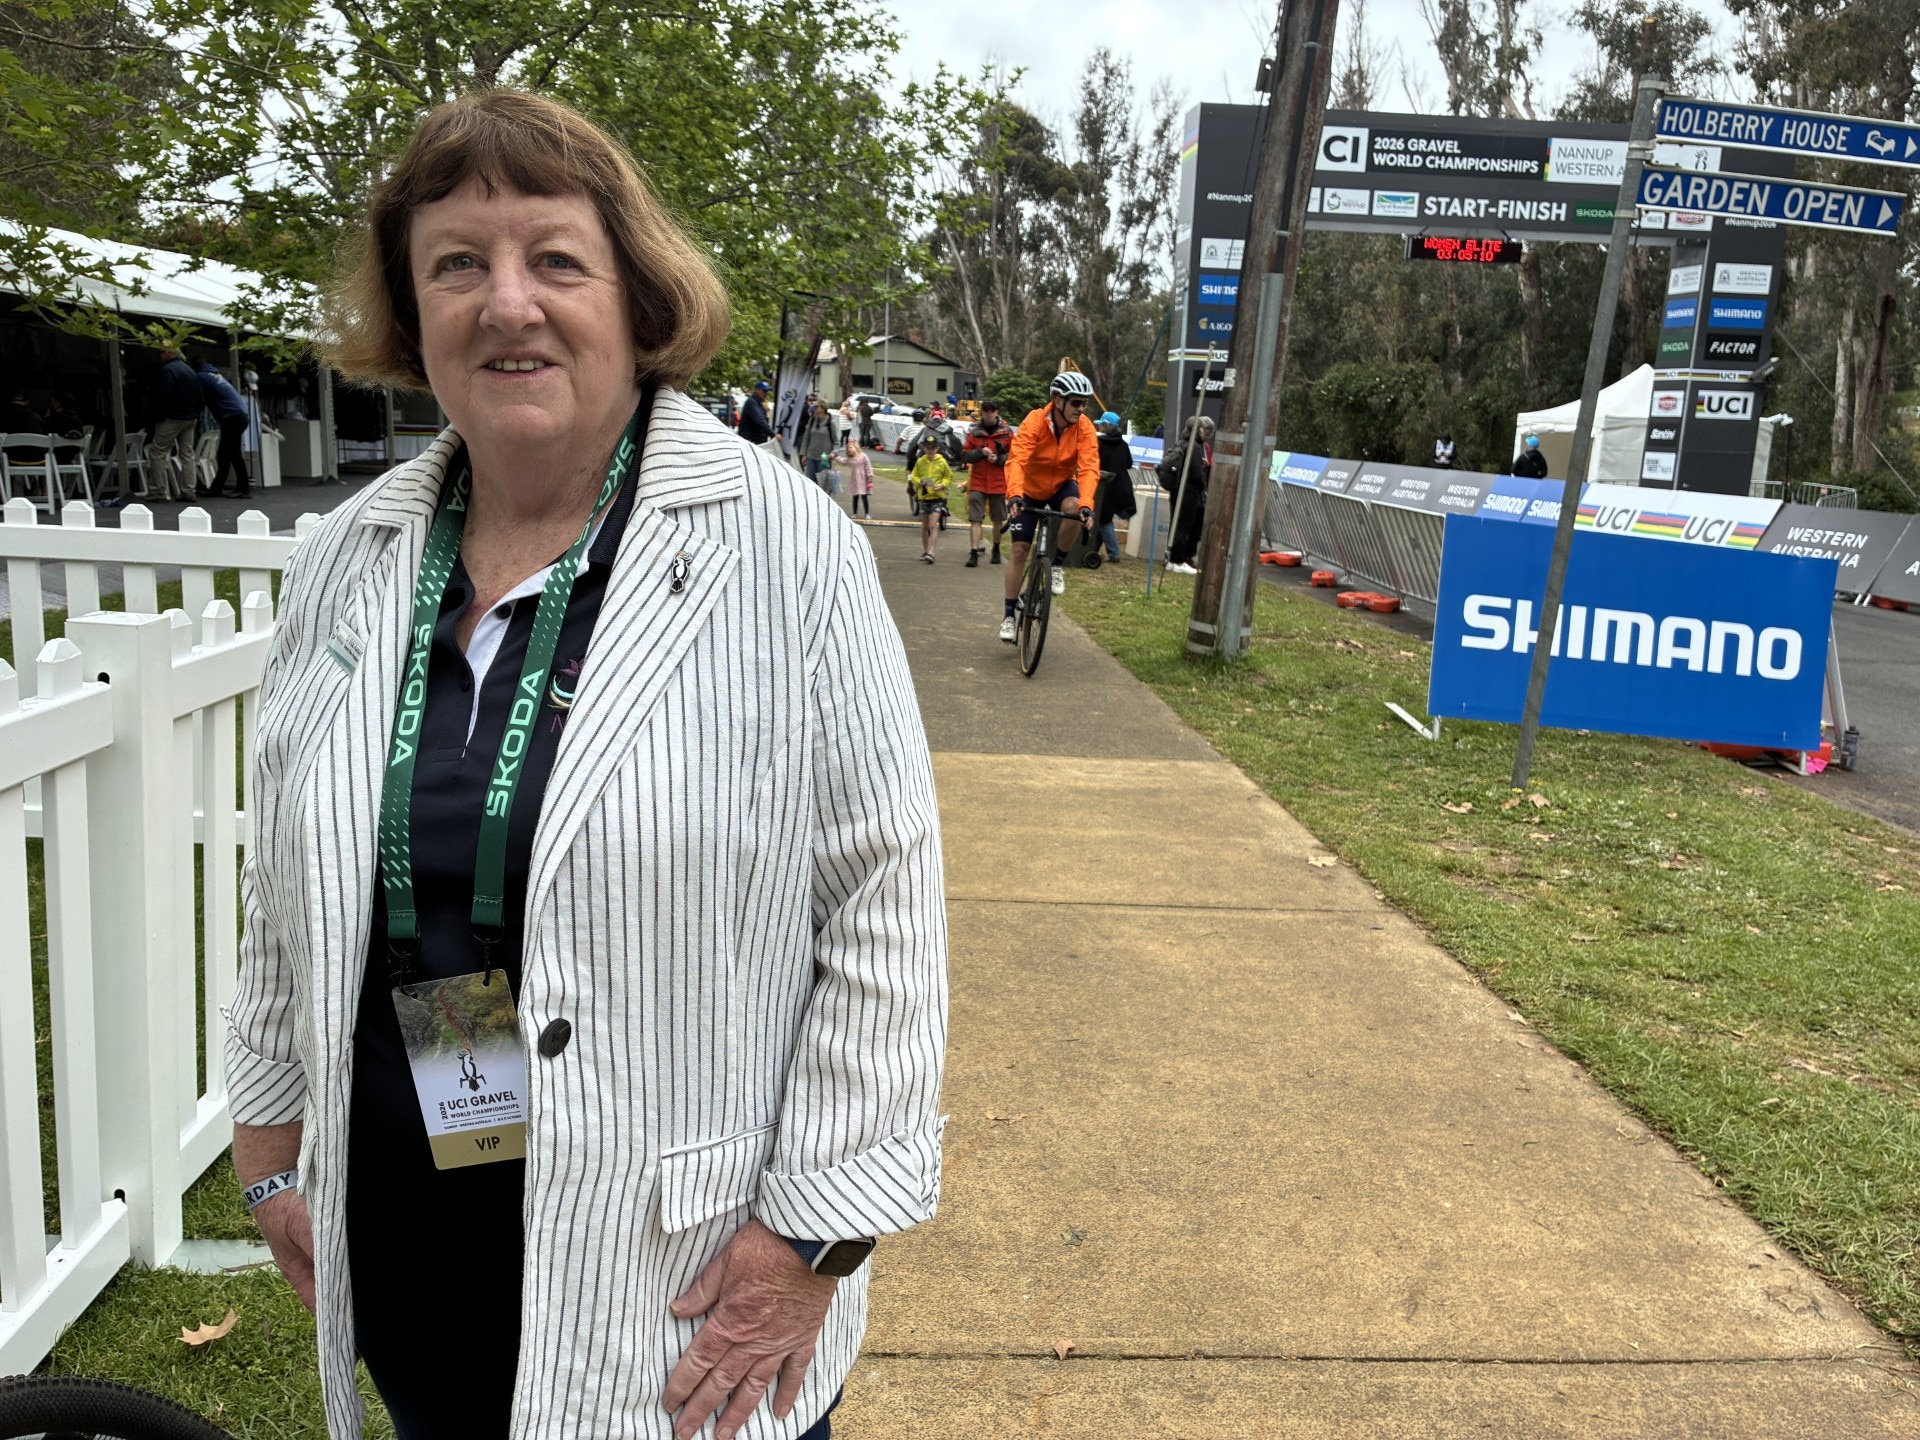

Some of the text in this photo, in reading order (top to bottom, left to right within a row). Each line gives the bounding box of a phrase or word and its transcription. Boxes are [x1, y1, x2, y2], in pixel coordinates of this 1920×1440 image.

[1662, 105, 1850, 151] HOLBERRY HOUSE
[1323, 135, 1360, 164] CI
[1373, 137, 1461, 154] 2026 GRAVEL
[1557, 146, 1613, 160] NANNUP
[1373, 152, 1539, 174] WORLD CHAMPIONSHIPS
[1555, 162, 1614, 177] WESTERN
[1643, 172, 1865, 227] GARDEN OPEN
[1424, 196, 1567, 222] START-FINISH
[1424, 237, 1502, 252] WOMEN ELITE
[1437, 250, 1494, 263] 03:05:10
[1201, 285, 1238, 296] SHIMA
[1713, 308, 1762, 320] SHIMANO
[1209, 322, 1233, 331] ARGO
[1709, 341, 1756, 354] FACTOR
[1215, 352, 1229, 360] UC
[1720, 372, 1736, 380] UCI
[1706, 396, 1748, 414] UCI
[1281, 466, 1319, 483] SHIMANO
[1361, 474, 1386, 484] WESTERN
[1400, 478, 1431, 490] WESTERN
[1447, 484, 1480, 496] WESTERN
[1391, 488, 1427, 501] AUSTRALIA
[1438, 495, 1475, 508] AUSTRALIA
[1482, 494, 1528, 515] SHIMANO
[1527, 500, 1562, 521] SHIMA
[1595, 505, 1637, 532] UCI
[1010, 523, 1023, 531] CC
[1682, 514, 1733, 544] UCI
[1787, 526, 1868, 549] WESTERN
[1461, 593, 1802, 681] SHIMANO
[447, 1090, 517, 1111] UCI GRAVEL
[438, 1102, 448, 1120] 2026
[450, 1103, 520, 1119] WORLD CHAMPIONSHIPS
[475, 1136, 500, 1151] VIP
[244, 1173, 291, 1206] RDAY
